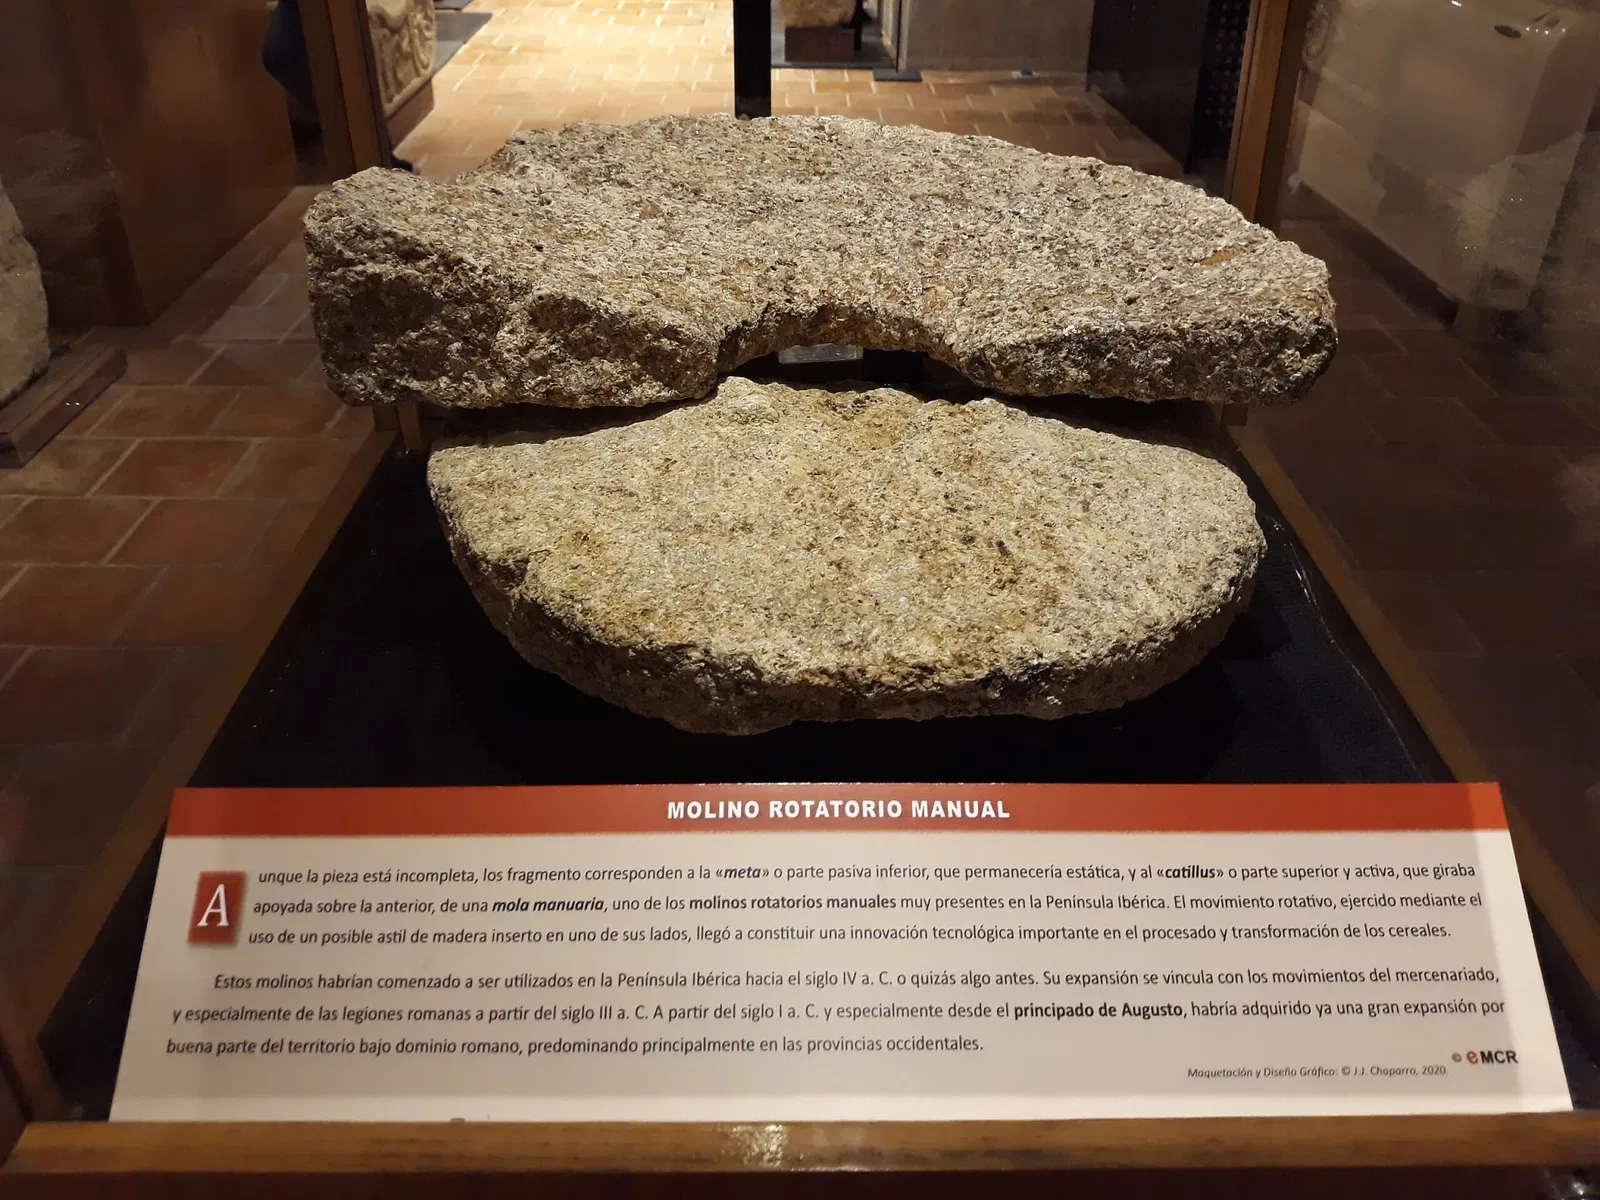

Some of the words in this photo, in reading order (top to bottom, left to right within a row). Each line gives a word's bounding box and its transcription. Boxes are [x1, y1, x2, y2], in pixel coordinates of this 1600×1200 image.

[667, 800, 759, 818] MOLINO
[769, 799, 901, 818] ROTATORIO
[911, 800, 1009, 817] MANUAL
[258, 872, 303, 886] unque
[306, 868, 318, 883] la
[321, 869, 358, 886] pieza
[362, 867, 391, 883] está
[395, 867, 478, 885] incompleta,
[482, 867, 503, 882] los
[507, 866, 581, 885] fragmento
[584, 864, 682, 883] corresponden
[699, 864, 710, 879] la
[715, 865, 769, 879] «meta»
[786, 865, 823, 881] parte
[828, 863, 871, 881] pasiva
[876, 863, 929, 880] inferior,
[933, 867, 960, 881] que
[964, 864, 1062, 881] permanecería
[1066, 864, 1124, 881] estática,
[1139, 864, 1152, 879] al
[1156, 864, 1224, 879] «catillus»
[1240, 865, 1278, 881] parte
[1281, 864, 1338, 881] superior
[1354, 863, 1399, 879] activa,
[1402, 866, 1429, 880] que
[1432, 862, 1475, 880] giraba
[197, 883, 229, 927] A
[252, 898, 313, 916] apoyada
[316, 898, 356, 913] sobre
[359, 898, 372, 913] la
[375, 898, 435, 915] anterior,
[439, 897, 458, 912] de
[461, 901, 488, 912] una
[491, 897, 529, 912] mola
[532, 895, 607, 913] manuaria,
[612, 899, 639, 911] uno
[643, 895, 661, 910] de
[665, 895, 685, 911] los
[689, 894, 747, 910] molinos
[750, 894, 822, 909] rotatorios
[826, 893, 896, 909] manuales
[900, 897, 931, 912] muy
[935, 895, 1004, 912] presentes
[1008, 897, 1025, 909] en
[1029, 893, 1041, 909] la
[1045, 893, 1113, 909] Península
[1117, 893, 1169, 909] Ibérica.
[1173, 893, 1186, 909] El
[1189, 894, 1274, 909] movimiento
[1277, 893, 1336, 910] rotativo,
[1339, 892, 1396, 911] ejercido
[1399, 891, 1466, 907] mediante
[1469, 891, 1482, 906] el
[248, 932, 274, 944] uso
[277, 928, 295, 944] de
[299, 932, 317, 943] un
[320, 928, 373, 946] posible
[377, 928, 406, 944] astil
[410, 928, 428, 943] de
[432, 928, 487, 943] madera
[491, 928, 542, 943] inserto
[545, 930, 563, 942] en
[568, 930, 596, 942] uno
[600, 926, 618, 942] de
[622, 929, 645, 941] sus
[649, 925, 691, 943] lados,
[696, 924, 730, 944] llegó
[747, 925, 815, 940] constituir
[819, 928, 845, 940] una
[850, 923, 927, 940] innovación
[932, 923, 1014, 943] tecnológica
[1018, 924, 1099, 943] importante
[1103, 928, 1121, 939] en
[1125, 924, 1138, 940] el
[1141, 923, 1216, 942] procesado
[1231, 922, 1339, 939] transformación
[1343, 922, 1361, 938] de
[1363, 922, 1385, 938] los
[1388, 922, 1451, 937] cereales.
[213, 973, 252, 989] Estos
[255, 973, 313, 989] molinos
[317, 973, 372, 989] habrían
[376, 973, 461, 989] comenzado
[477, 976, 501, 989] ser
[504, 972, 573, 989] utilizados
[577, 976, 596, 988] en
[600, 971, 612, 987] la
[617, 971, 687, 988] Península
[691, 970, 740, 987] Ibérica
[745, 970, 783, 987] hacia
[787, 969, 800, 986] el
[805, 970, 838, 989] siglo
[842, 970, 857, 986] IV
[910, 969, 956, 988] quizás
[960, 969, 990, 988] algo
[995, 971, 1038, 985] antes.
[1042, 970, 1060, 985] Su
[1064, 968, 1138, 988] expansión
[1142, 973, 1158, 985] se
[1161, 968, 1213, 984] vincula
[1217, 972, 1243, 984] con
[1246, 968, 1268, 984] los
[1271, 968, 1365, 984] movimientos
[1368, 966, 1391, 983] del
[1394, 965, 1499, 984] mercenariado,
[184, 1005, 291, 1024] especialmente
[295, 1005, 314, 1021] de
[317, 1005, 338, 1021] las
[341, 1005, 403, 1024] legiones
[407, 1009, 471, 1021] romanas
[488, 1005, 530, 1024] partir
[533, 1004, 556, 1020] del
[560, 1004, 594, 1024] siglo
[598, 1004, 612, 1020] III
[668, 1003, 709, 1023] partir
[713, 1002, 736, 1019] del
[740, 1002, 774, 1023] siglo
[836, 1001, 943, 1022] especialmente
[947, 1001, 992, 1018] desde
[996, 1001, 1009, 1018] el
[1013, 1001, 1094, 1021] principado
[1097, 1001, 1117, 1017] de
[1121, 1002, 1187, 1020] Augusto,
[1190, 1000, 1237, 1016] habría
[1241, 999, 1311, 1019] adquirido
[1314, 1003, 1332, 1018] ya
[1336, 1002, 1363, 1015] una
[1367, 1002, 1399, 1018] gran
[1403, 997, 1477, 1017] expansión
[1480, 1001, 1505, 1016] por
[165, 1037, 213, 1054] buena
[215, 1039, 257, 1057] parte
[260, 1037, 284, 1054] del
[287, 1037, 355, 1053] territorio
[358, 1037, 391, 1057] bajo
[395, 1037, 457, 1053] dominio
[460, 1041, 522, 1056] romano,
[527, 1036, 638, 1056] predominando
[642, 1036, 755, 1056] principalmente
[759, 1039, 777, 1052] en
[782, 1035, 802, 1052] las
[807, 1035, 882, 1054] provincias
[886, 1034, 983, 1051] occidentales.
[1187, 1066, 1252, 1079] Maquetación
[1263, 1066, 1297, 1078] Diseño
[1369, 1065, 1418, 1077] Chaparro,
